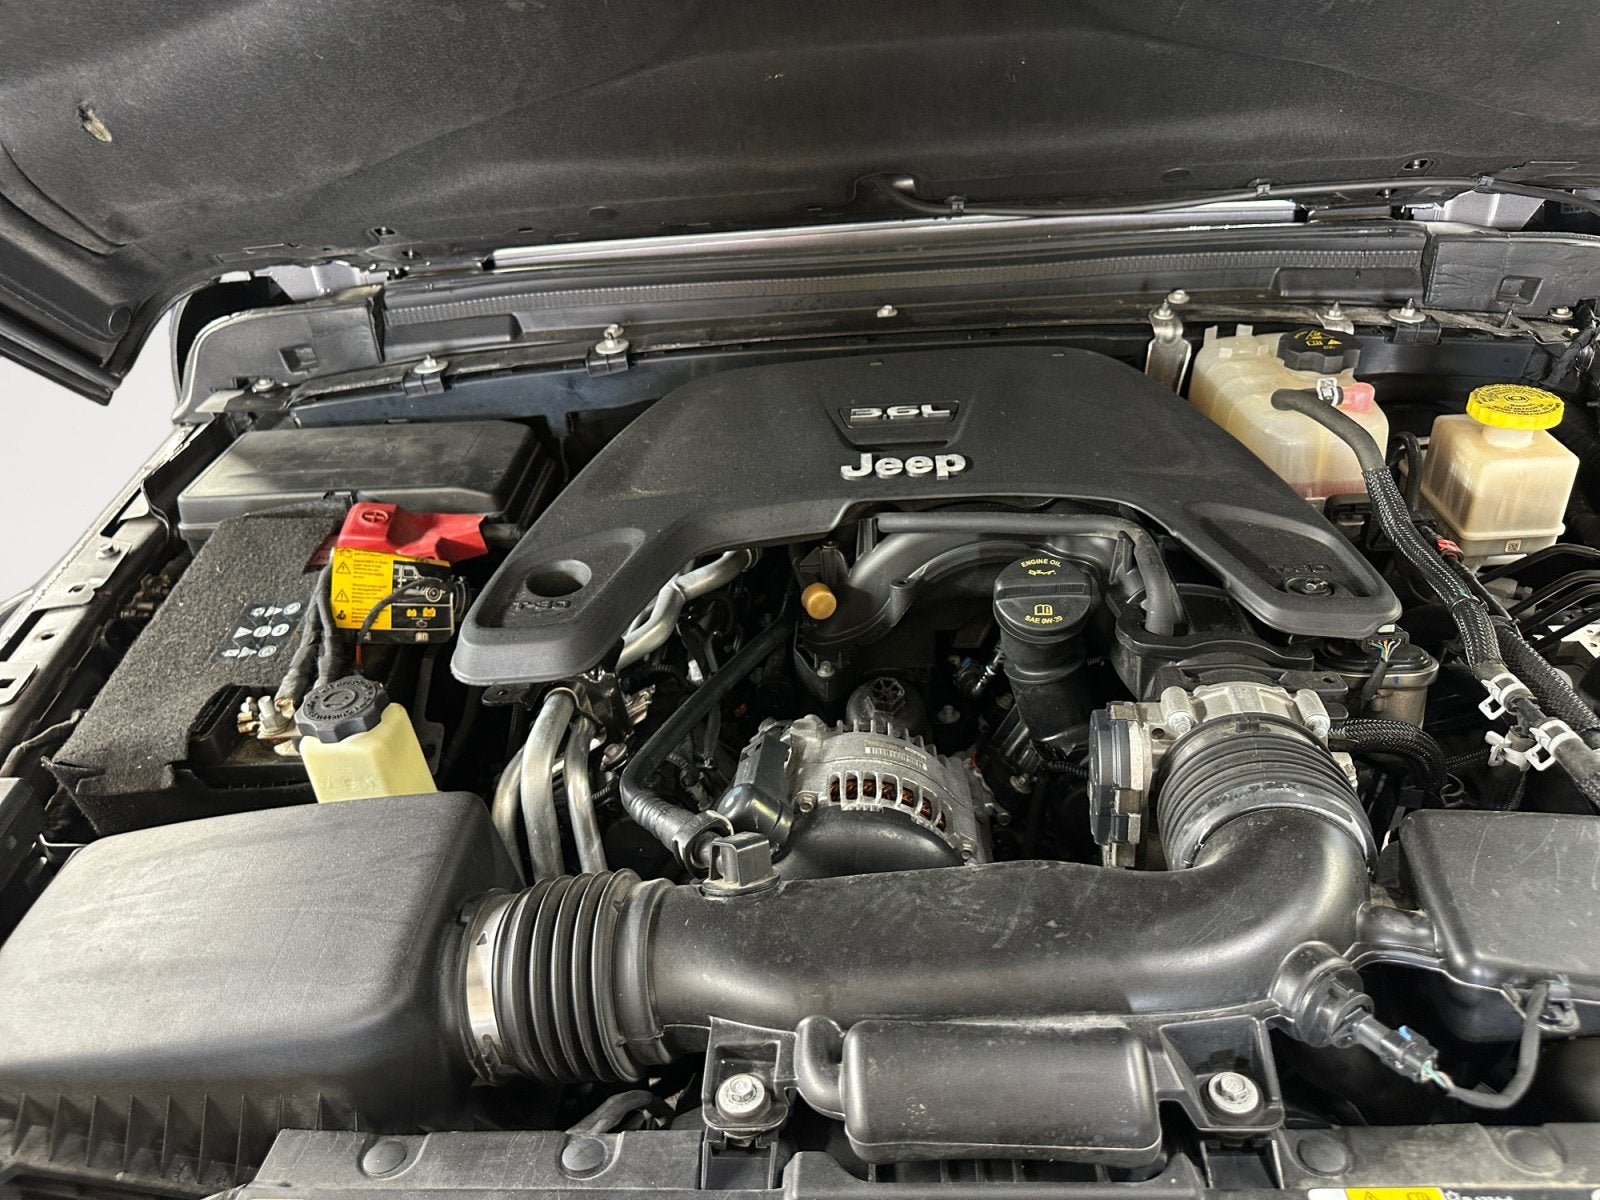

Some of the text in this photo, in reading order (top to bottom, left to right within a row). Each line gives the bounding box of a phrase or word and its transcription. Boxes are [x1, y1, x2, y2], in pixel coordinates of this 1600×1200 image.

[850, 404, 950, 421] 3.6L
[840, 453, 967, 480] Jeep
[1020, 558, 1062, 568] ENGINE OIL
[1024, 615, 1041, 624] SAE
